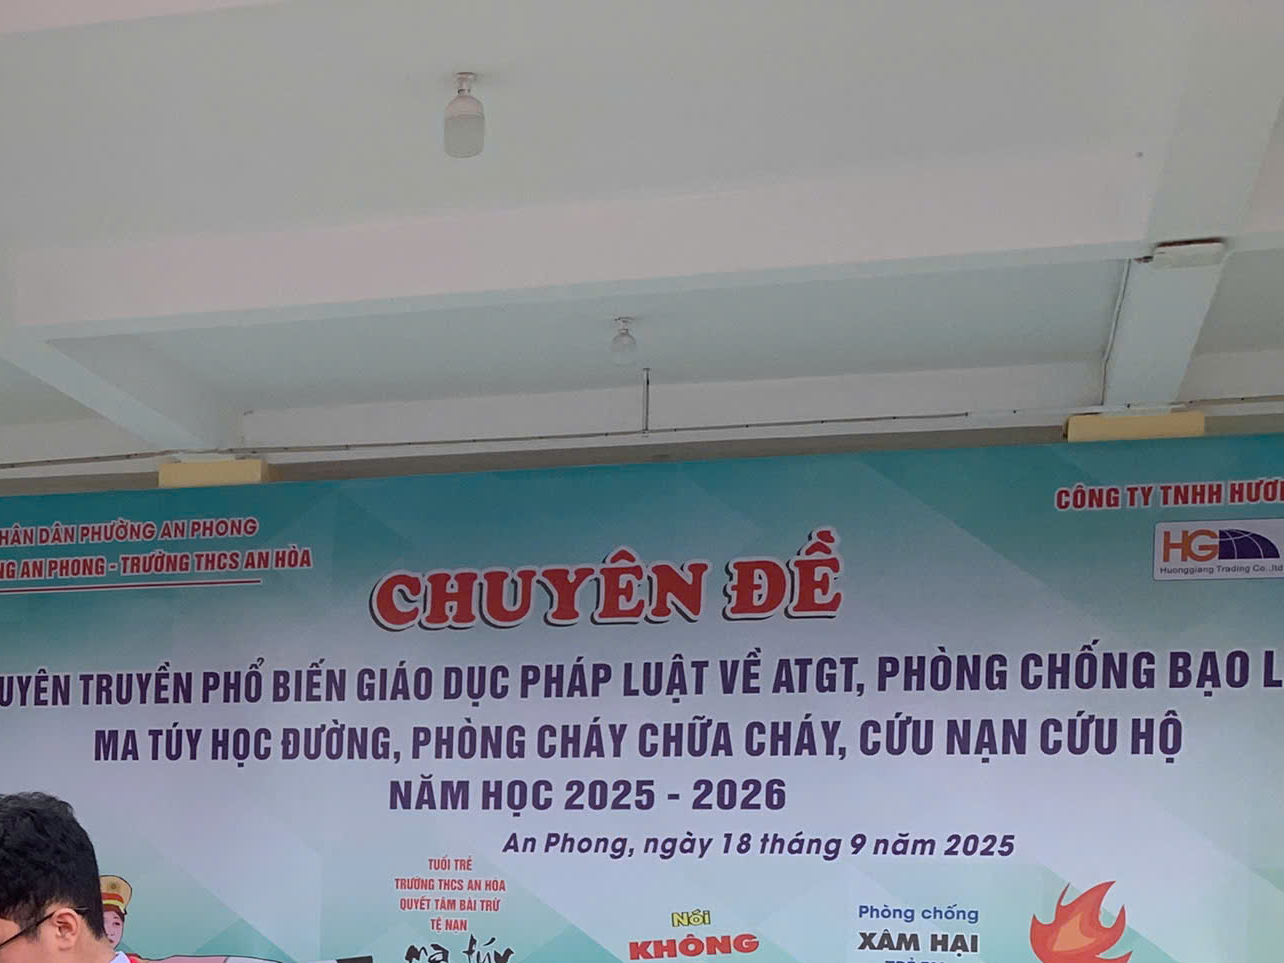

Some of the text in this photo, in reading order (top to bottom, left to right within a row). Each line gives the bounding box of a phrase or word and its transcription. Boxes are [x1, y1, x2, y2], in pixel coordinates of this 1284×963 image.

[1056, 484, 1120, 510] CÔNG
[1126, 486, 1154, 507] TY
[1159, 483, 1222, 506] TNHH
[38, 522, 75, 544] DÂN
[80, 519, 156, 543] PHƯỜNG
[160, 521, 185, 539] AN
[190, 518, 259, 538] PHONG
[1163, 529, 1219, 562] HG
[20, 559, 44, 579] AN
[48, 556, 106, 578] PHONG
[121, 549, 190, 574] TRƯỜNG
[195, 552, 240, 572] THCS
[244, 551, 270, 569] AN
[274, 544, 312, 568] HÒA
[1159, 566, 1214, 576] Huonggiang
[1216, 564, 1251, 575] Trading
[372, 528, 843, 630] CHUYÊN ĐỀ
[79, 661, 192, 705] TRUYỀN
[202, 657, 265, 704] PHỔ
[272, 658, 346, 702] BIẾN
[357, 660, 433, 701] GIÁO
[444, 664, 510, 707] DỤC
[520, 656, 612, 699] PHÁP
[623, 653, 709, 703] LUẬT
[719, 647, 762, 694] VỀ
[772, 656, 865, 697] ATGT,
[877, 646, 1008, 692] PHÒNG
[1020, 639, 1156, 690] CHỐNG
[1169, 650, 1250, 697] BẠO
[94, 710, 1183, 768] MA TÚY HỌC ĐƯỜNG, PHÒNG CHÁY CHỮA CHÁY, CỨU NẠN CỨU HỘ
[389, 774, 786, 818] NĂM HỌC 2025 - 2026
[502, 831, 1015, 862] An Phong, ngày 18 tháng 9 năm 2025
[428, 855, 472, 871] TUỐI TRẺ
[438, 878, 464, 891] THCS
[467, 879, 482, 891] AN
[400, 895, 431, 911] QUYẾT
[434, 897, 456, 911] TÂM
[459, 897, 476, 911] BÀI
[858, 903, 979, 924] Phòng chống
[430, 916, 467, 934] TỆ NẠN
[671, 908, 711, 927] Nói
[628, 933, 760, 960] KHÔNG
[857, 928, 979, 957] XÂM HẠI
